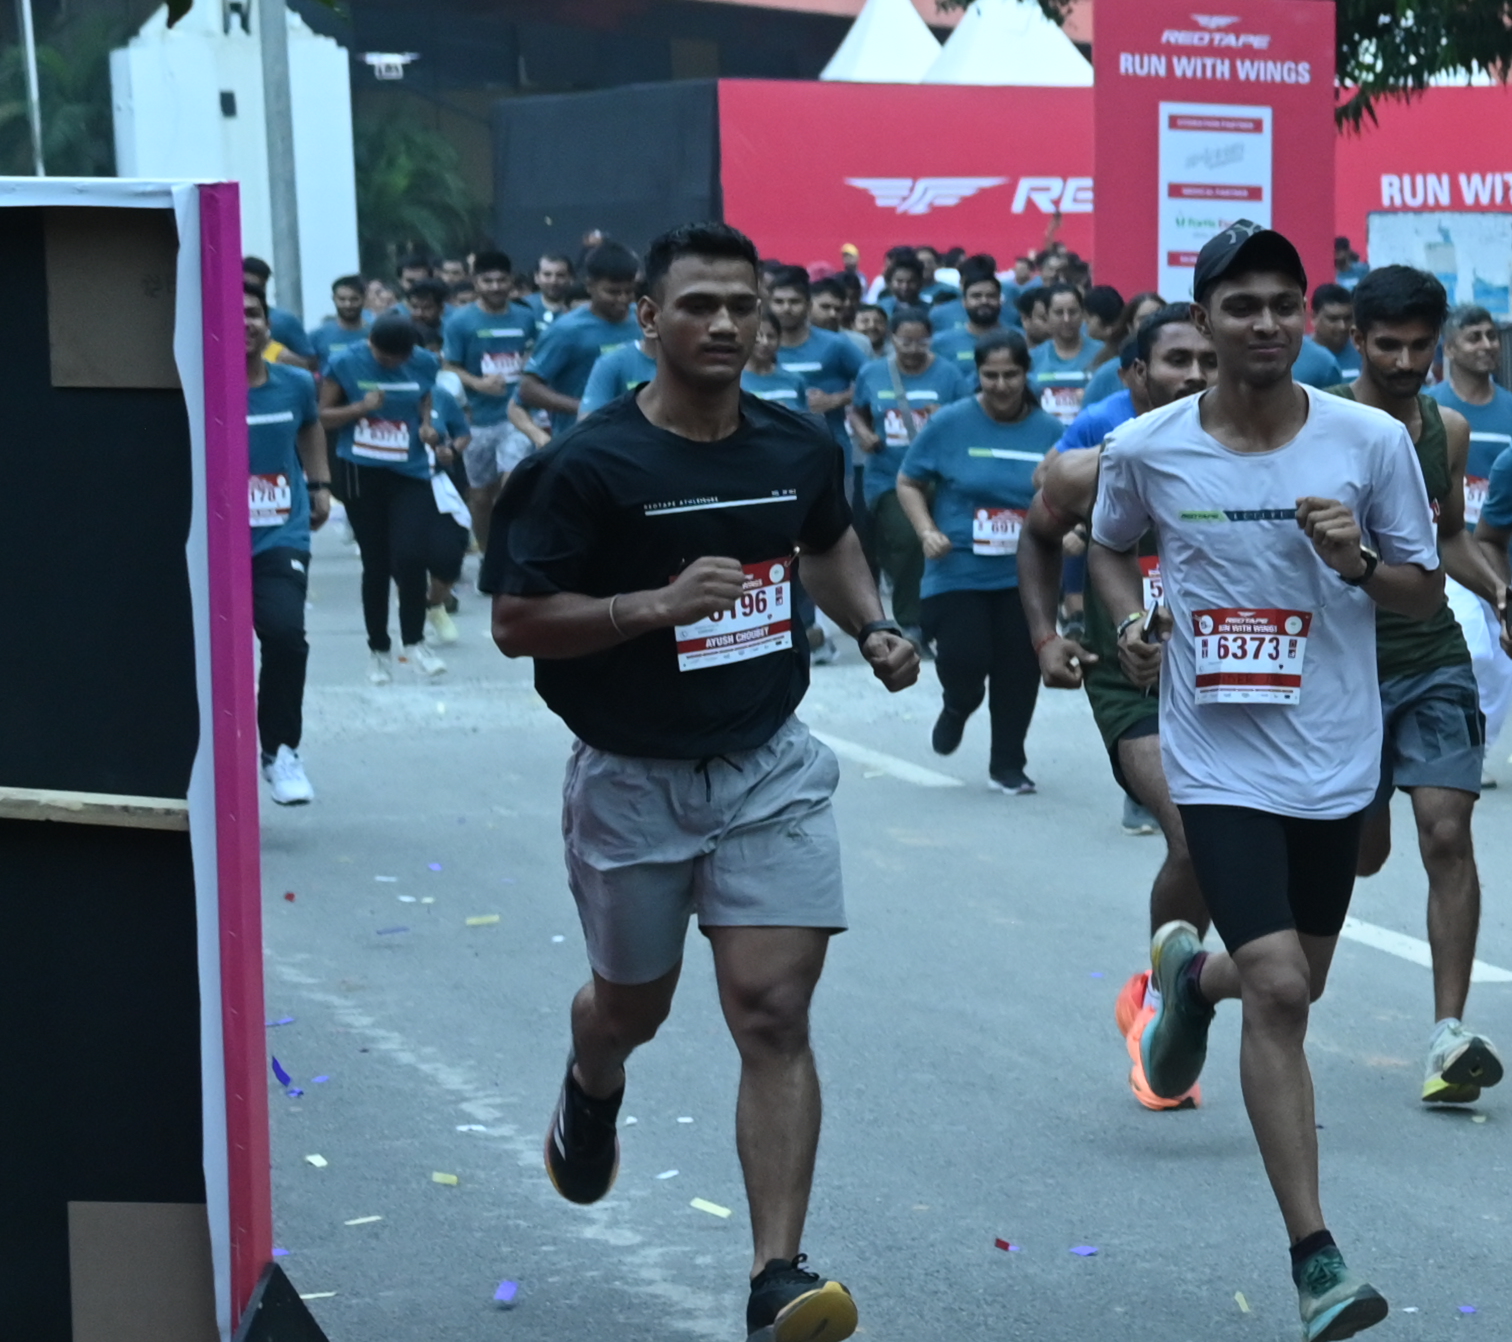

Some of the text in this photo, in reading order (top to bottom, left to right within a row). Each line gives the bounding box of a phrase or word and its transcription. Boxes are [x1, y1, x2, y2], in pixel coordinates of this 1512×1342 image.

[1161, 29, 1271, 50] REDTAPE
[1119, 52, 1311, 84] RUN WITH WINGS
[1381, 173, 1450, 207] RUN
[706, 634, 734, 648] AYUSH
[1218, 636, 1280, 661] 6373
